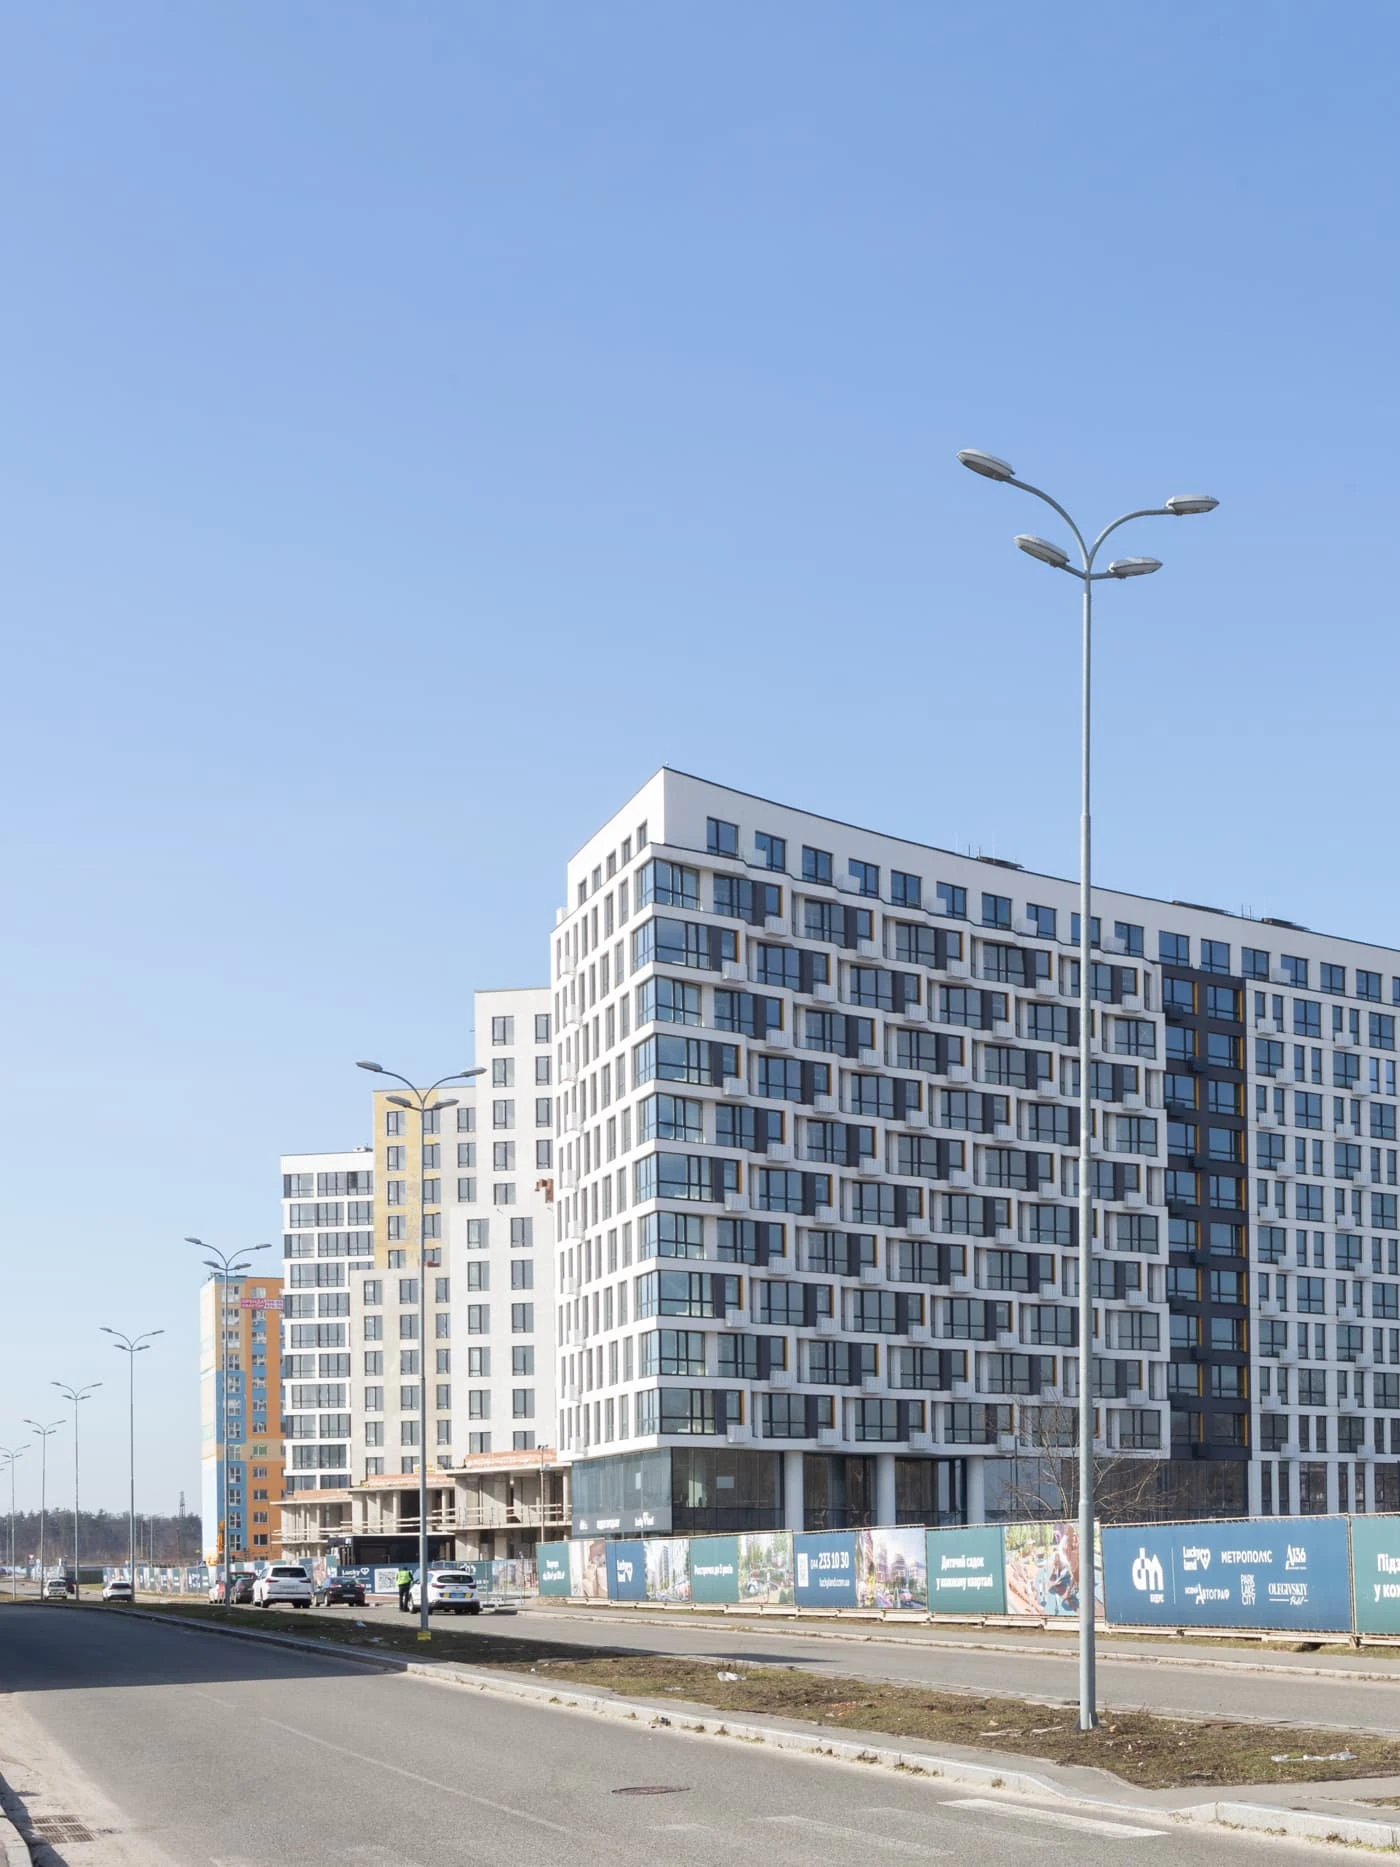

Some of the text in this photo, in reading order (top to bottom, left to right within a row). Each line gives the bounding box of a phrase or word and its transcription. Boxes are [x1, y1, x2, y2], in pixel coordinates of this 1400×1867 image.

[818, 1552, 831, 1569] 233
[831, 1552, 840, 1569] 10
[840, 1552, 849, 1569] 30
[1374, 1584, 1382, 1602] у
